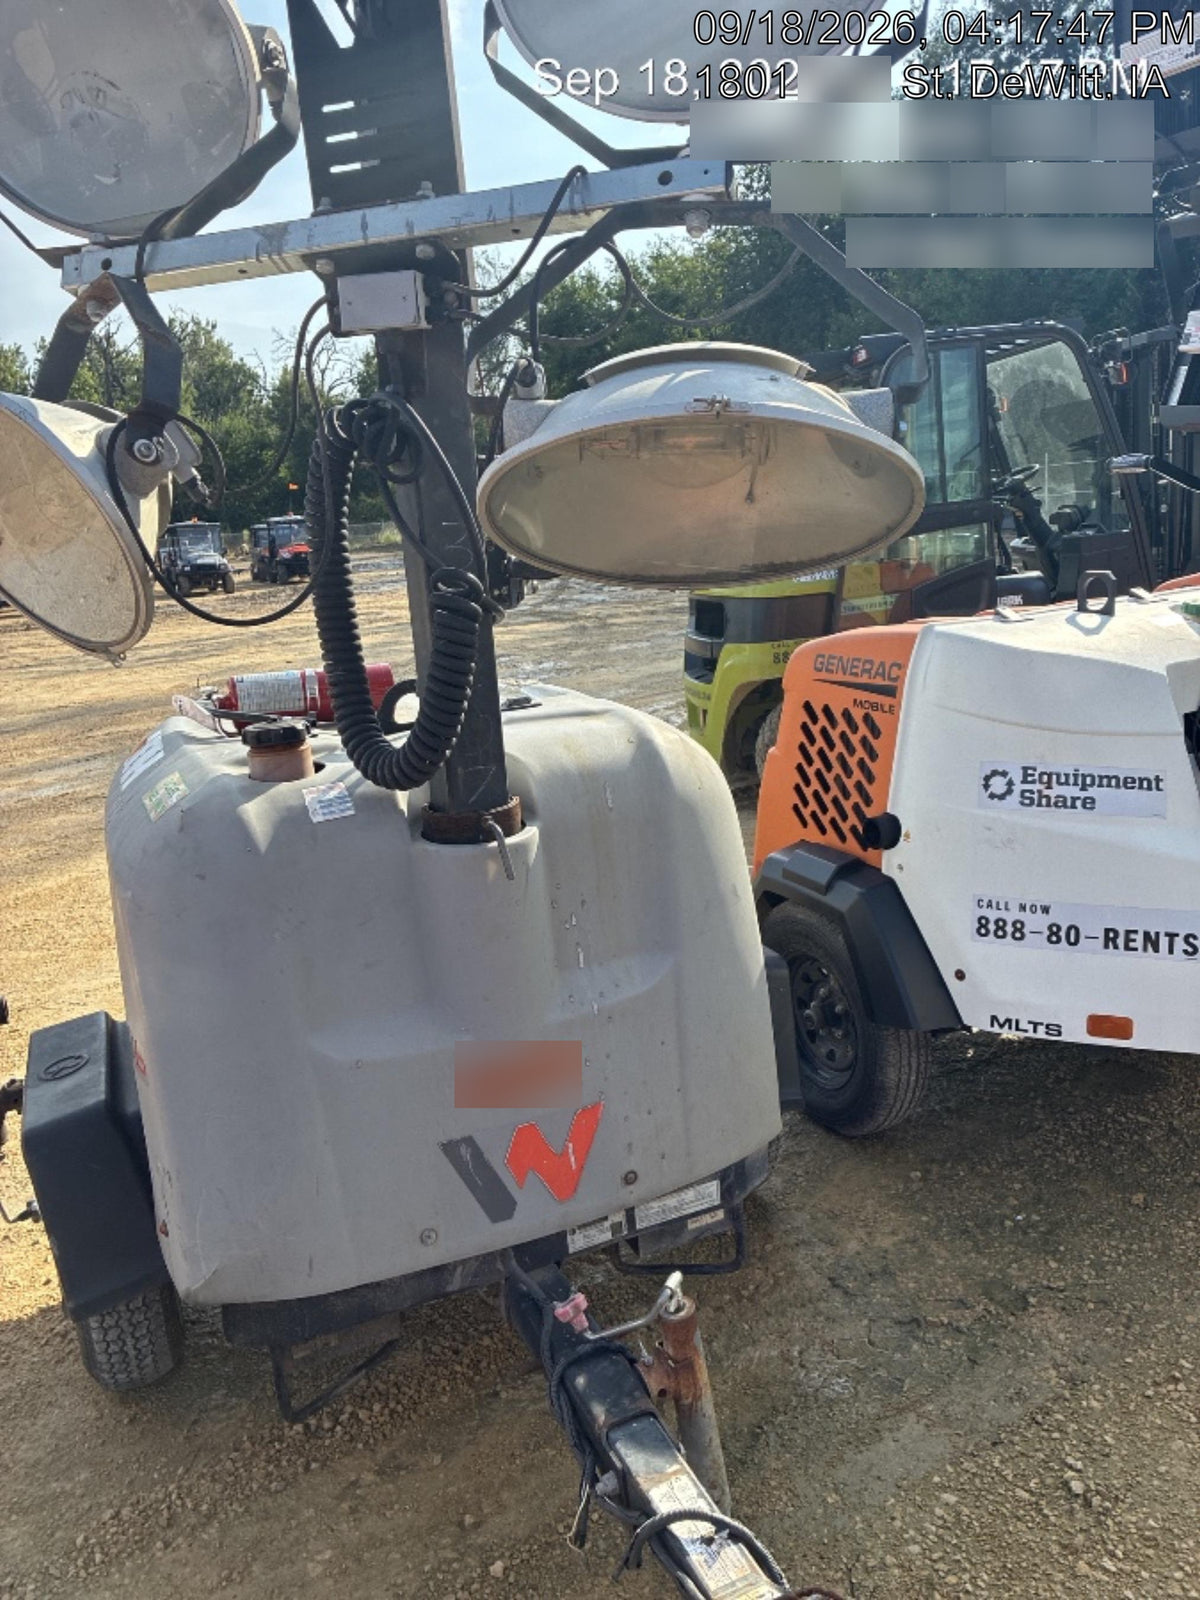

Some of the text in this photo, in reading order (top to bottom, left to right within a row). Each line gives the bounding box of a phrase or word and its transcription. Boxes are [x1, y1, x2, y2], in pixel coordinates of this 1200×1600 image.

[813, 653, 902, 683] GENERAC
[852, 698, 896, 715] MOBILE
[1020, 765, 1165, 792] Equipment
[1018, 789, 1097, 811] Share
[976, 898, 1051, 915] CALL NOW
[975, 915, 1199, 957] 888-80-RENTS
[989, 1014, 1063, 1037] MLTS
